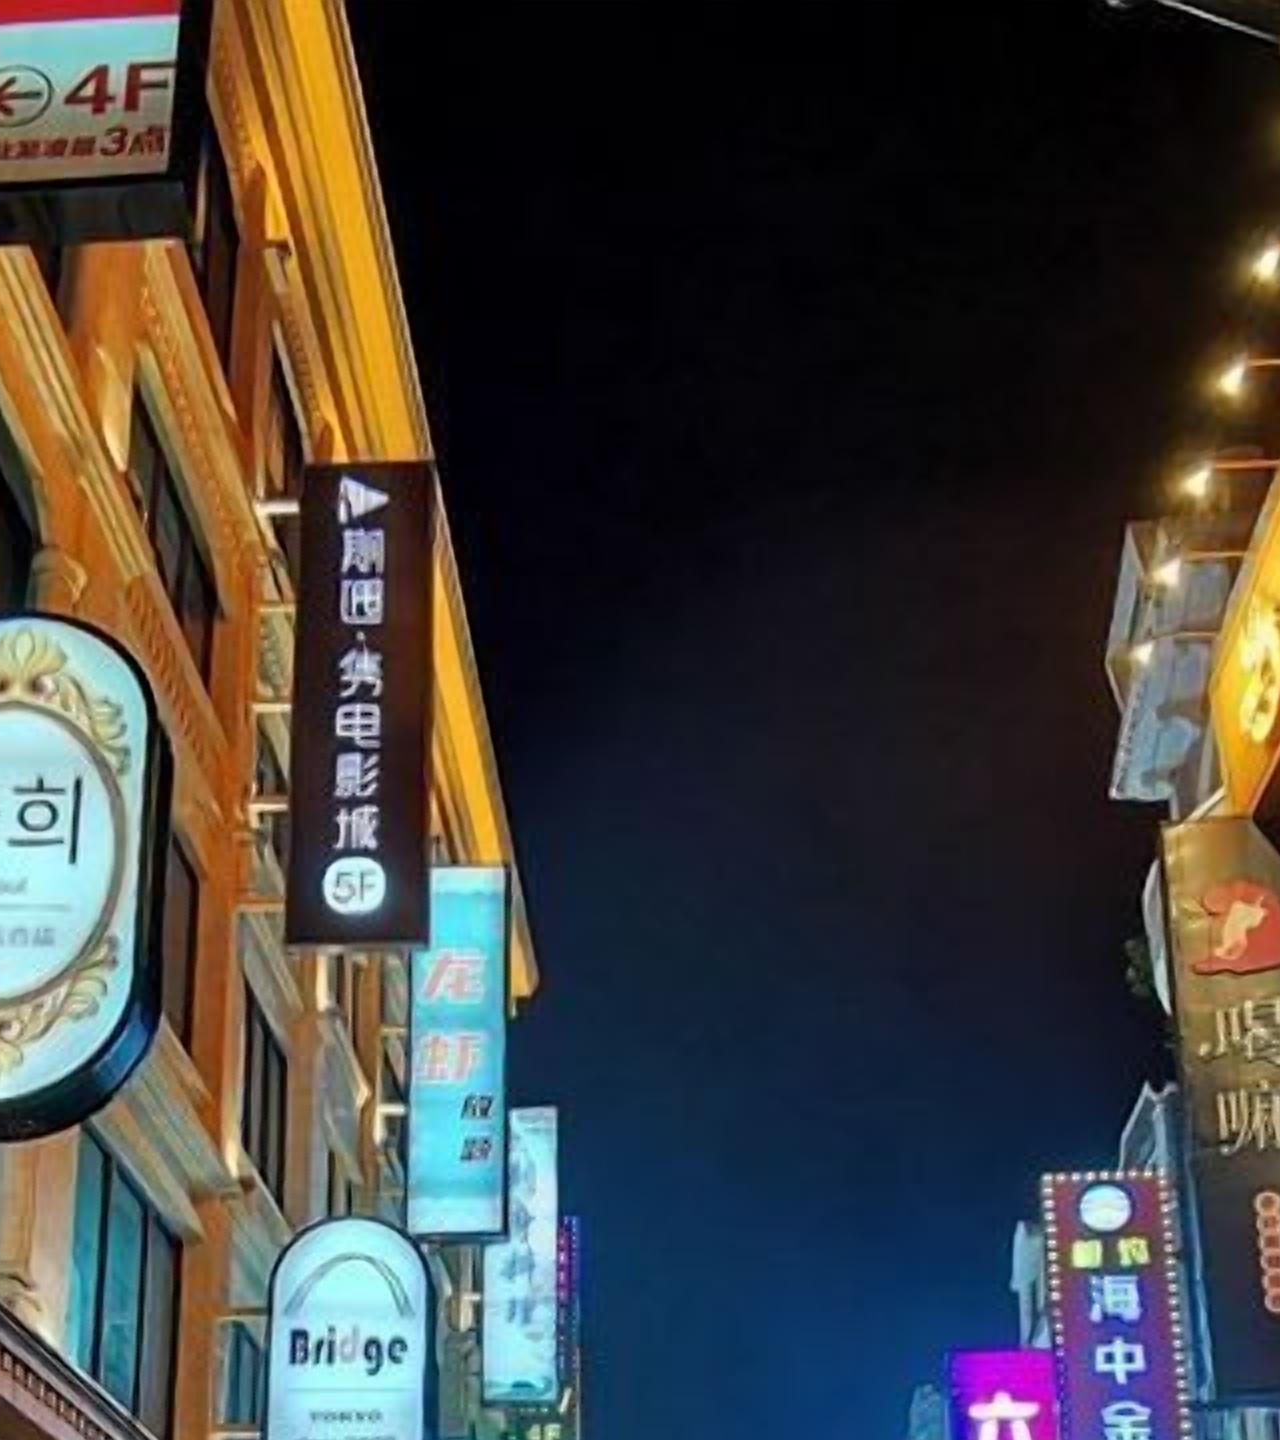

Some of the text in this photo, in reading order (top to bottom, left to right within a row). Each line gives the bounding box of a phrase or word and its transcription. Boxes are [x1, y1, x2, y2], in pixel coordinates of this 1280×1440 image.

[64, 60, 177, 115] 4F
[330, 870, 378, 906] 5F
[288, 1324, 410, 1377] Bridge
